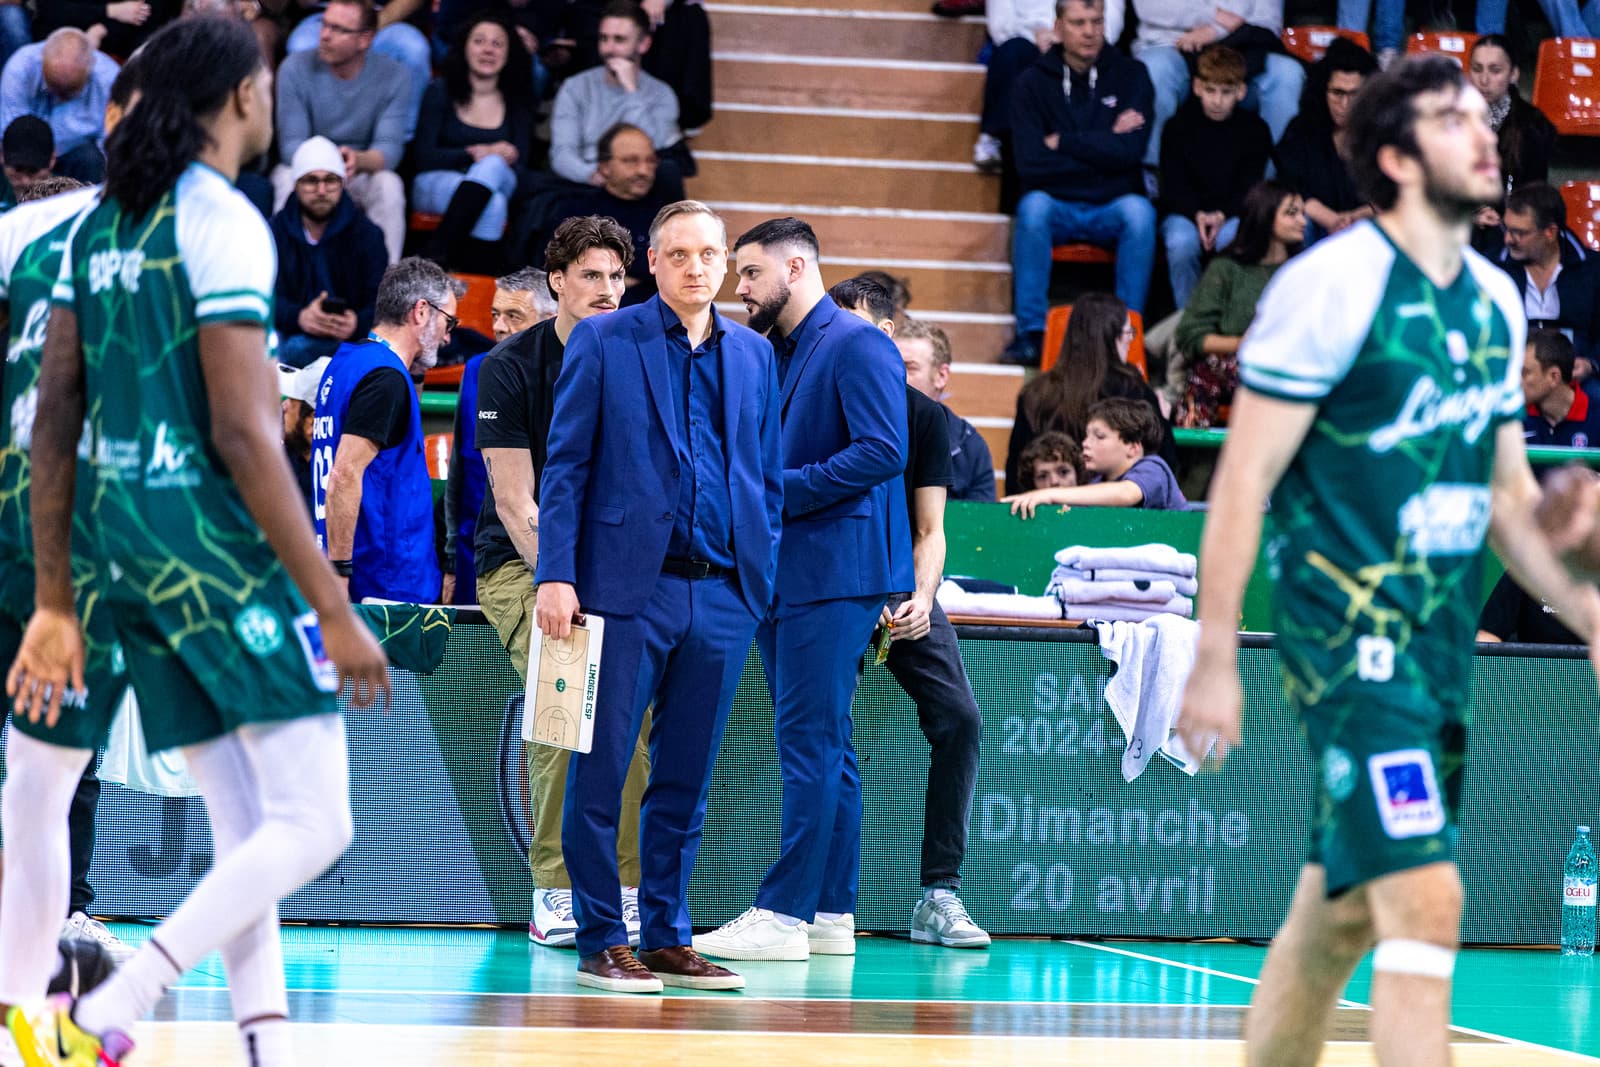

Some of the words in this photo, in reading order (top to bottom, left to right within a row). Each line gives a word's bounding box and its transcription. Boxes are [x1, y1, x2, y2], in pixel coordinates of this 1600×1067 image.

[586, 663, 597, 702] LIMOGES
[584, 702, 594, 720] CSP
[982, 794, 1249, 848] Dimanche
[1009, 862, 1074, 912] 20
[1097, 866, 1217, 915] avril
[1565, 887, 1591, 897] OGEU
